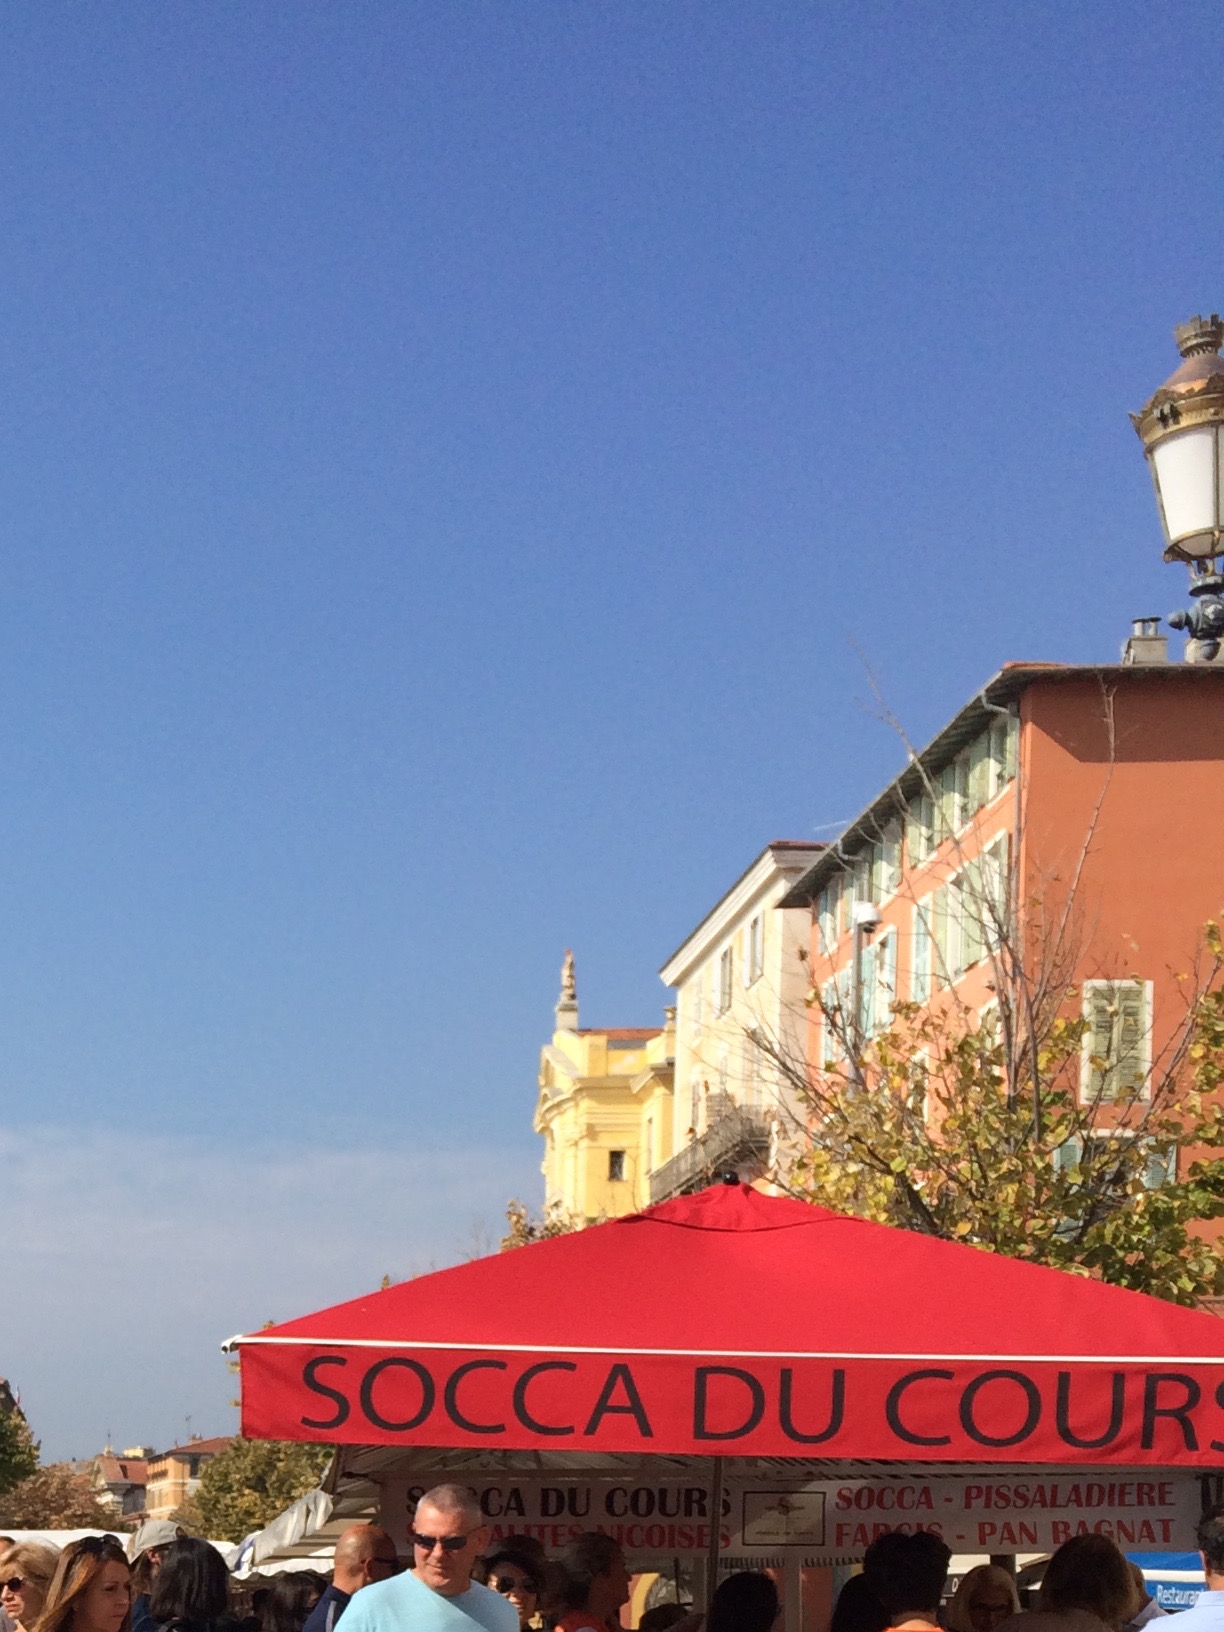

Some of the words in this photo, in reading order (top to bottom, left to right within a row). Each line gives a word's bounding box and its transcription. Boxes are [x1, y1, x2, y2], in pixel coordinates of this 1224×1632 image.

[300, 1355, 655, 1438] SOCCA
[692, 1366, 845, 1444] DU
[884, 1369, 1224, 1452] COUR
[406, 1486, 526, 1518] SCA
[540, 1487, 591, 1518] DU
[835, 1485, 935, 1511] SOCCA
[963, 1481, 1176, 1510] PISSALADIERE
[978, 1519, 1038, 1546] PAN
[1051, 1518, 1176, 1545] BAGNAT
